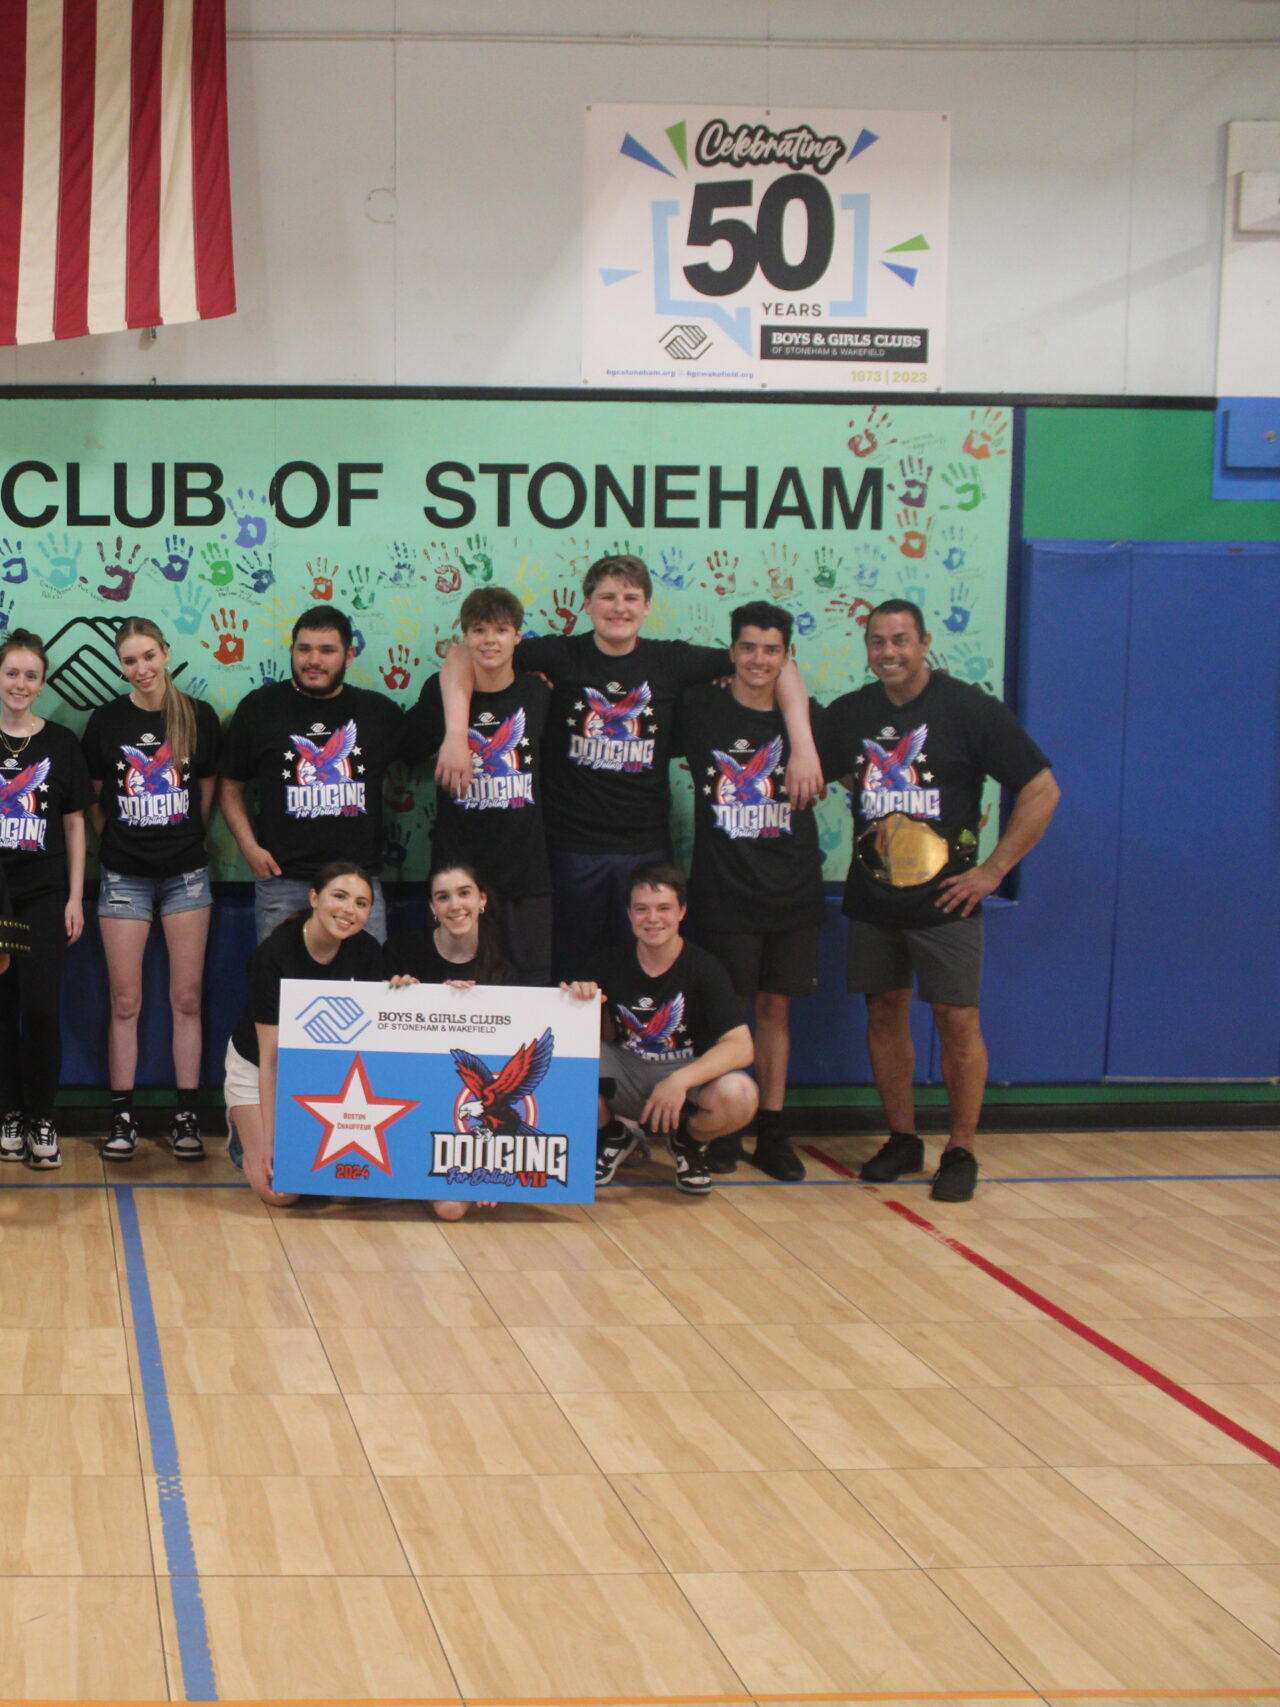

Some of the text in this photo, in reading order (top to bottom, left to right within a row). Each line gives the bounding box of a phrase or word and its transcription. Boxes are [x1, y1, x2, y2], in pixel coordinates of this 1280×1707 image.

[698, 120, 844, 173] Celebrating
[682, 173, 835, 297] 50
[761, 302, 823, 317] YEARS
[771, 332, 921, 348] BOYS & GIRLS CLUBS
[785, 347, 830, 355] STONEHAM
[832, 348, 838, 356] &
[840, 348, 885, 357] WAKEFIELD
[850, 370, 882, 383] 1973
[892, 371, 928, 384] 2023
[0, 460, 227, 529] CLUB
[268, 460, 383, 529] OF
[423, 461, 884, 530] STONEHAM
[569, 734, 655, 765] DODGING
[286, 782, 366, 812] DODGING
[377, 1022, 496, 1033] OF STONEHAM & WAKEFIELD
[378, 1011, 511, 1025] BOYS & GIRLS CLUBS
[430, 1133, 567, 1185] DODGING
[336, 1163, 370, 1180] 2024
[447, 1166, 548, 1188] For Dollars VII
